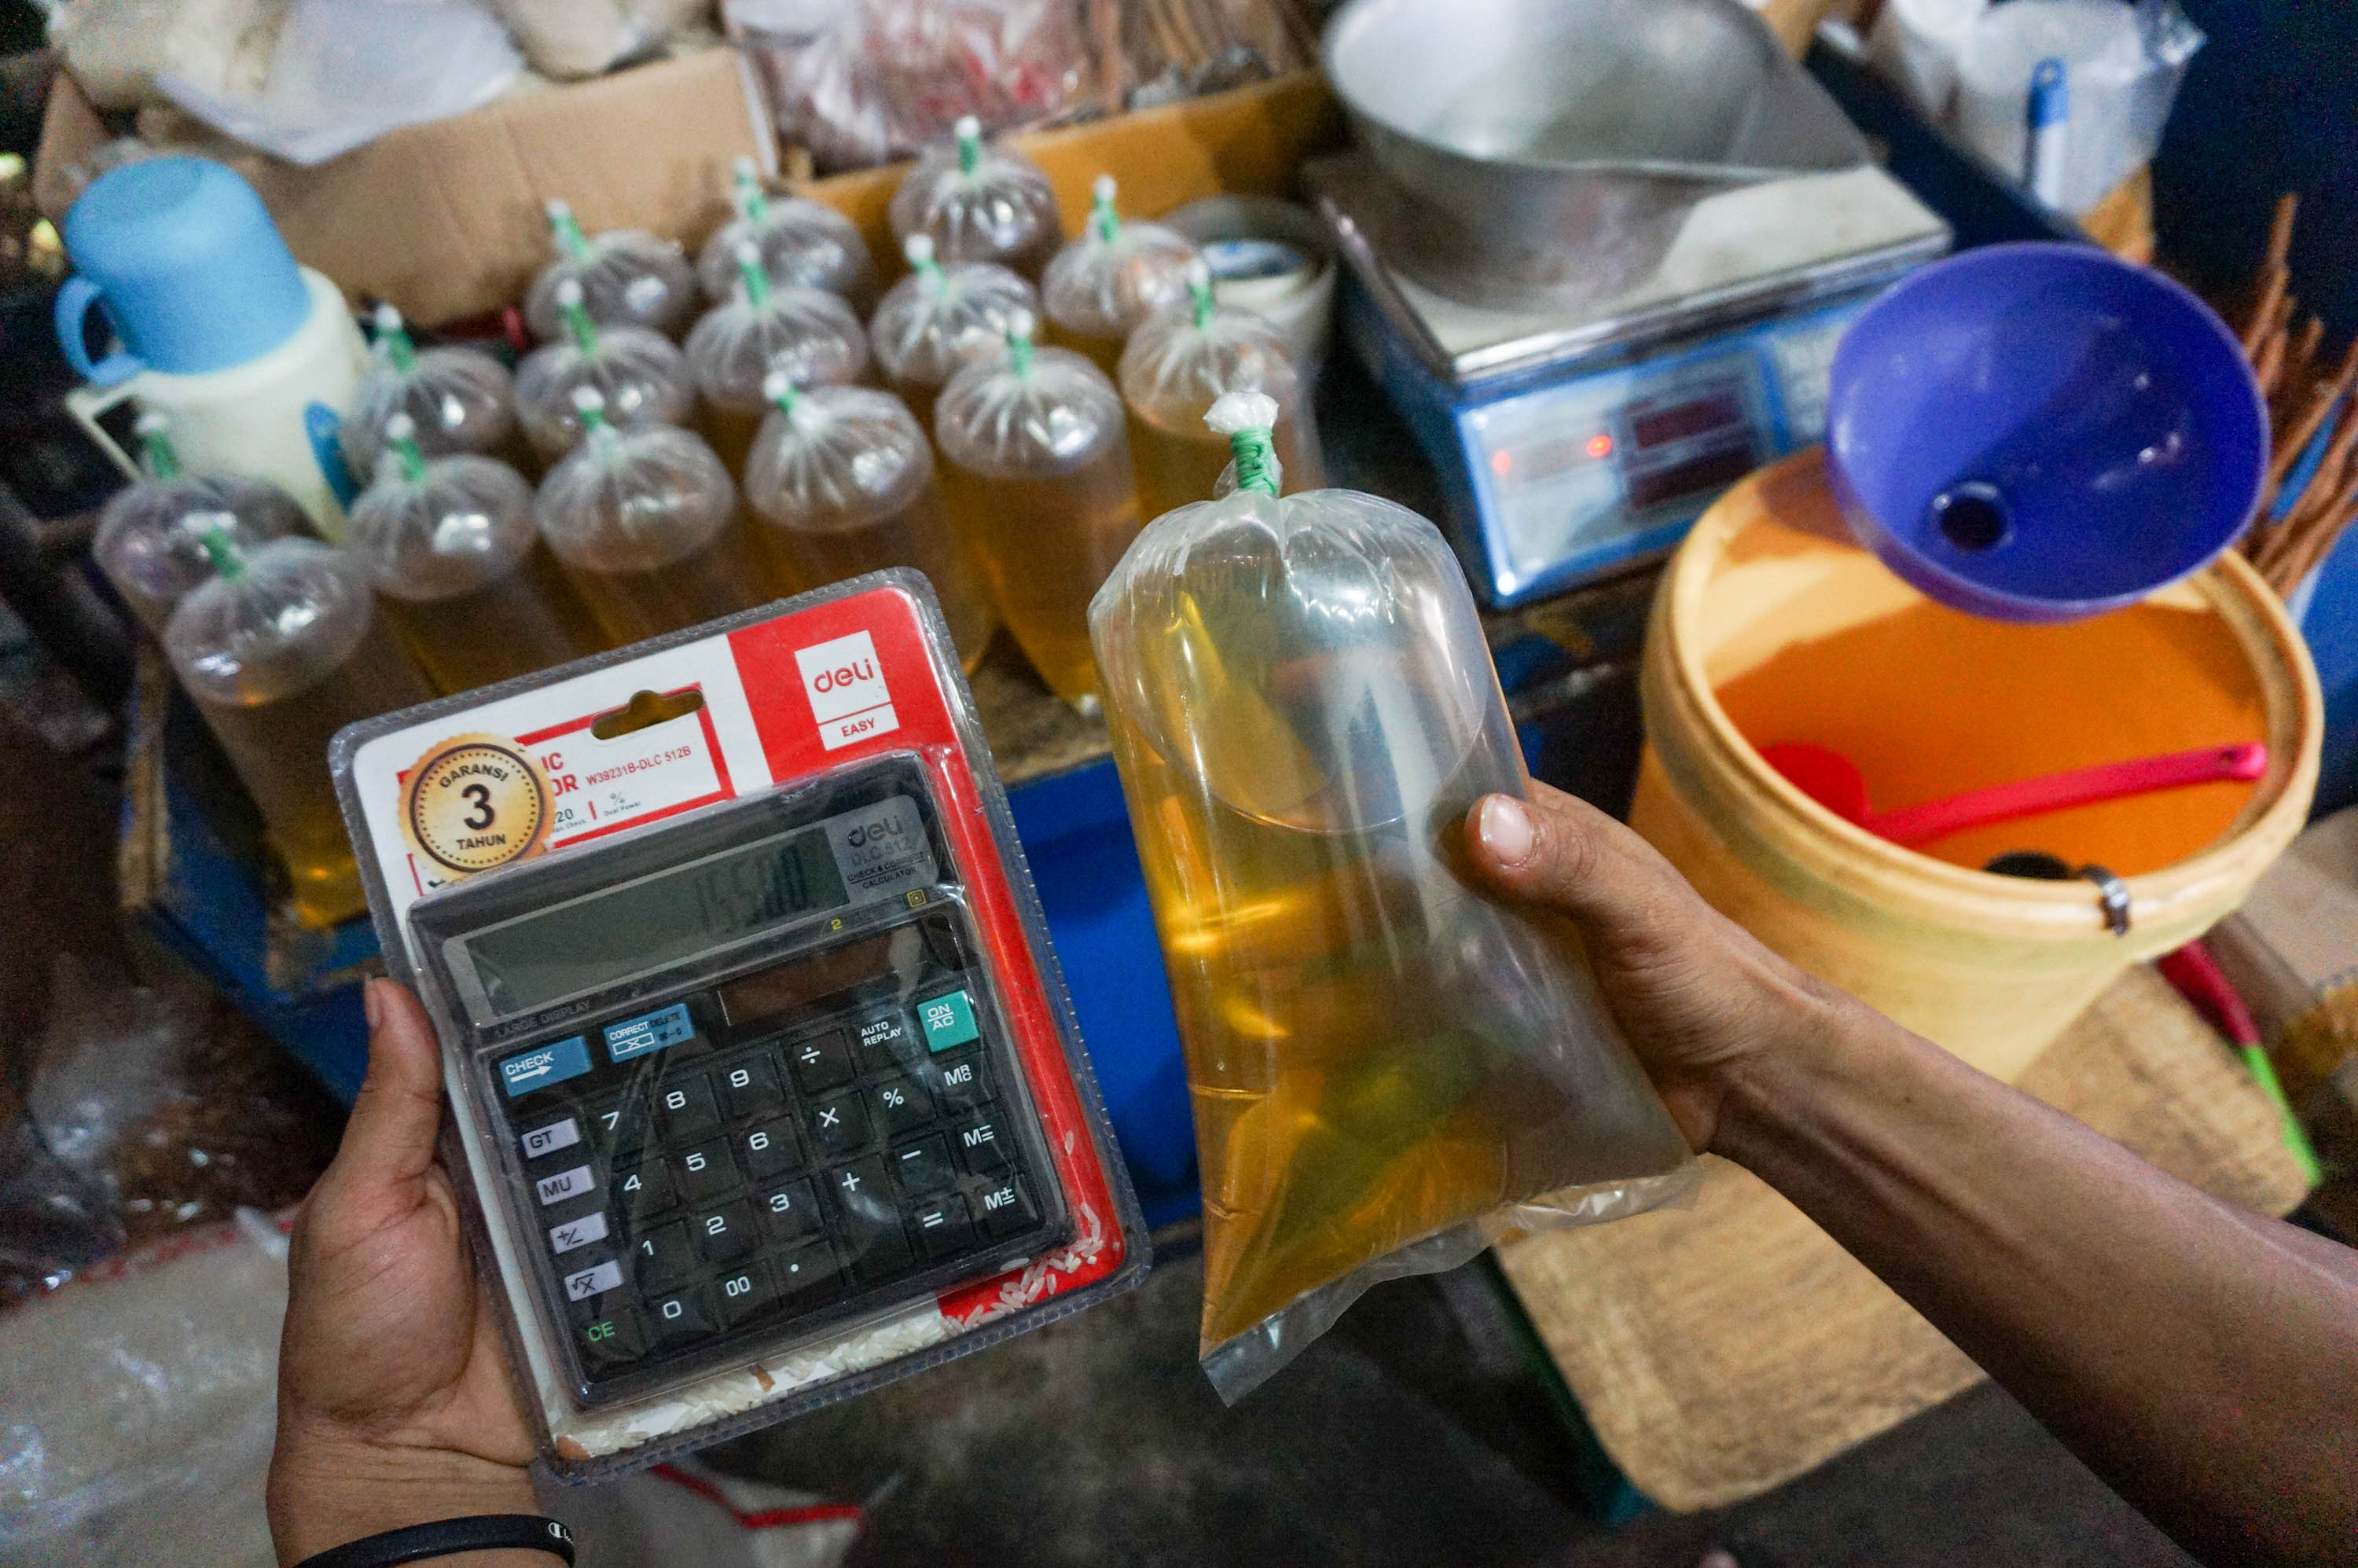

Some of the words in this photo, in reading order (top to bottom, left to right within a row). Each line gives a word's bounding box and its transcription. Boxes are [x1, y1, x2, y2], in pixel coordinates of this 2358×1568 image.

[814, 657, 875, 693] deli
[840, 717, 875, 737] EASY
[664, 745, 692, 762] 512B
[439, 763, 509, 788] GARANSI
[461, 783, 494, 831] 3
[848, 814, 904, 847] deli
[456, 834, 506, 850] TAHUN
[862, 866, 918, 889] CALCULATOR
[831, 917, 843, 931] 2
[927, 1002, 950, 1019] ON
[609, 1021, 649, 1041] CORRECT
[861, 1021, 889, 1037] AUTO
[932, 1015, 954, 1031] AC
[863, 1027, 902, 1047] REPLAY
[505, 1052, 554, 1076] CHECK
[730, 1069, 749, 1088] 9
[667, 1091, 685, 1109] 8
[883, 1088, 904, 1108] %
[601, 1111, 619, 1130] 7
[529, 1130, 553, 1148] GT
[749, 1132, 769, 1151] 6
[685, 1152, 706, 1171] 5
[542, 1177, 571, 1198] MU
[623, 1174, 642, 1192] 4
[769, 1193, 790, 1213] 3
[707, 1216, 727, 1235] 2
[641, 1239, 654, 1255] 1
[725, 1276, 751, 1297] 00
[663, 1301, 682, 1319] 0
[587, 1321, 615, 1342] CE
